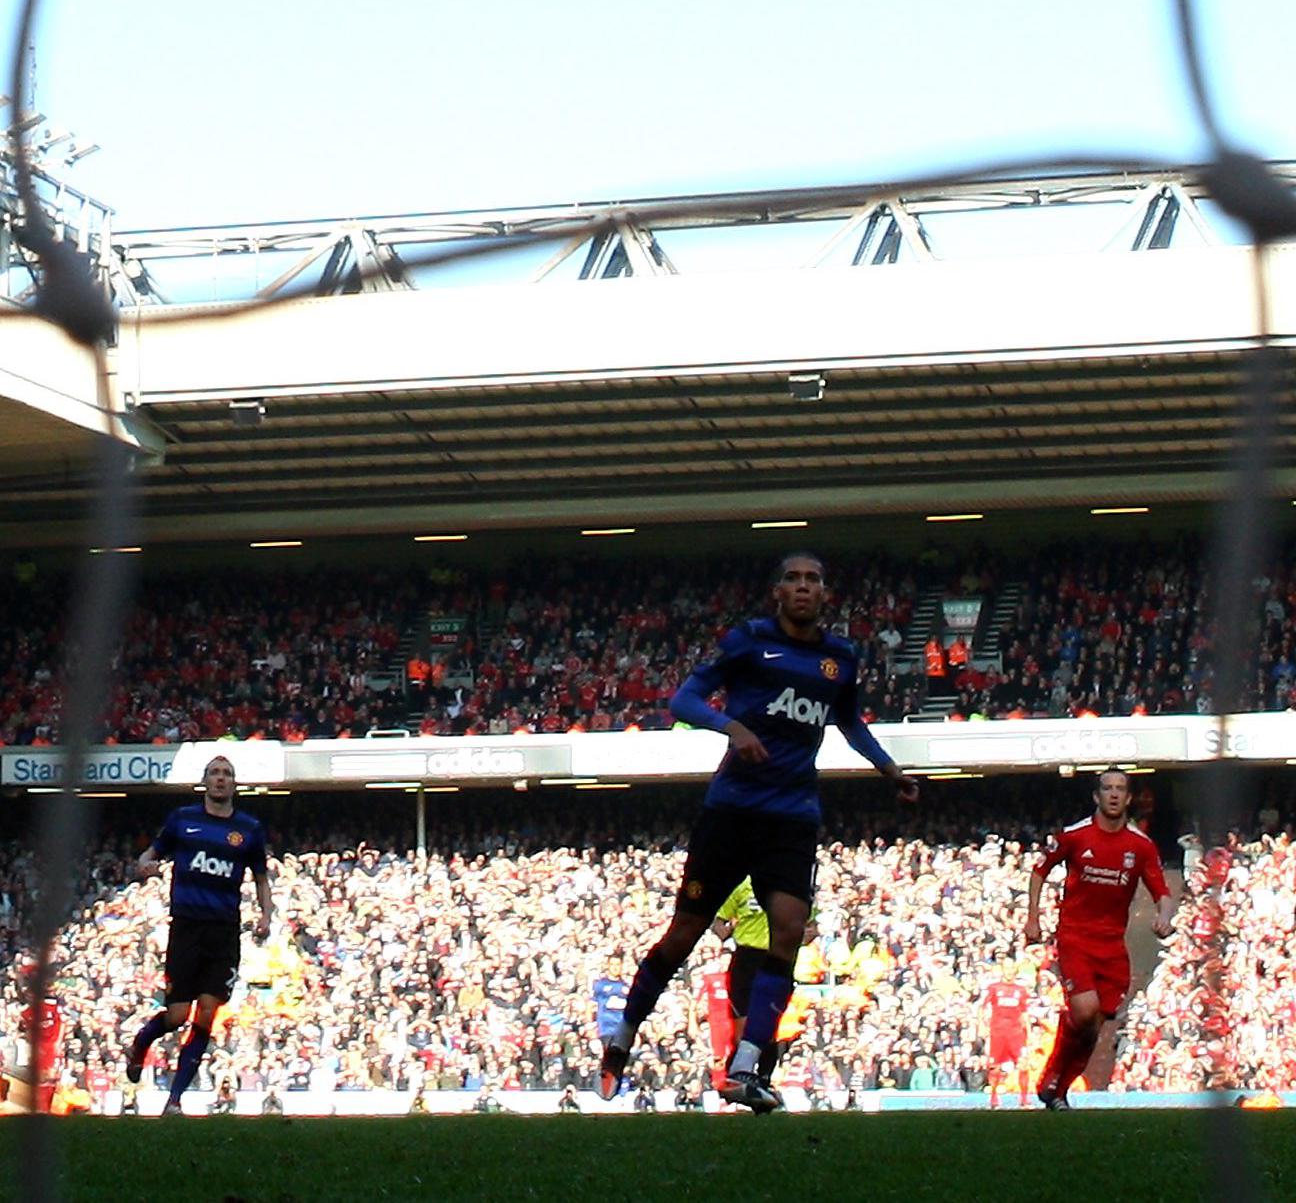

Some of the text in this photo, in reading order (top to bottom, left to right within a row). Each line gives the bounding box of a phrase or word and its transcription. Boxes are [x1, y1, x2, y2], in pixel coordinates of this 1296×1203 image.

[766, 686, 830, 728] AON
[14, 757, 122, 782] Stanard
[427, 747, 525, 775] adidas
[189, 850, 235, 879] AON
